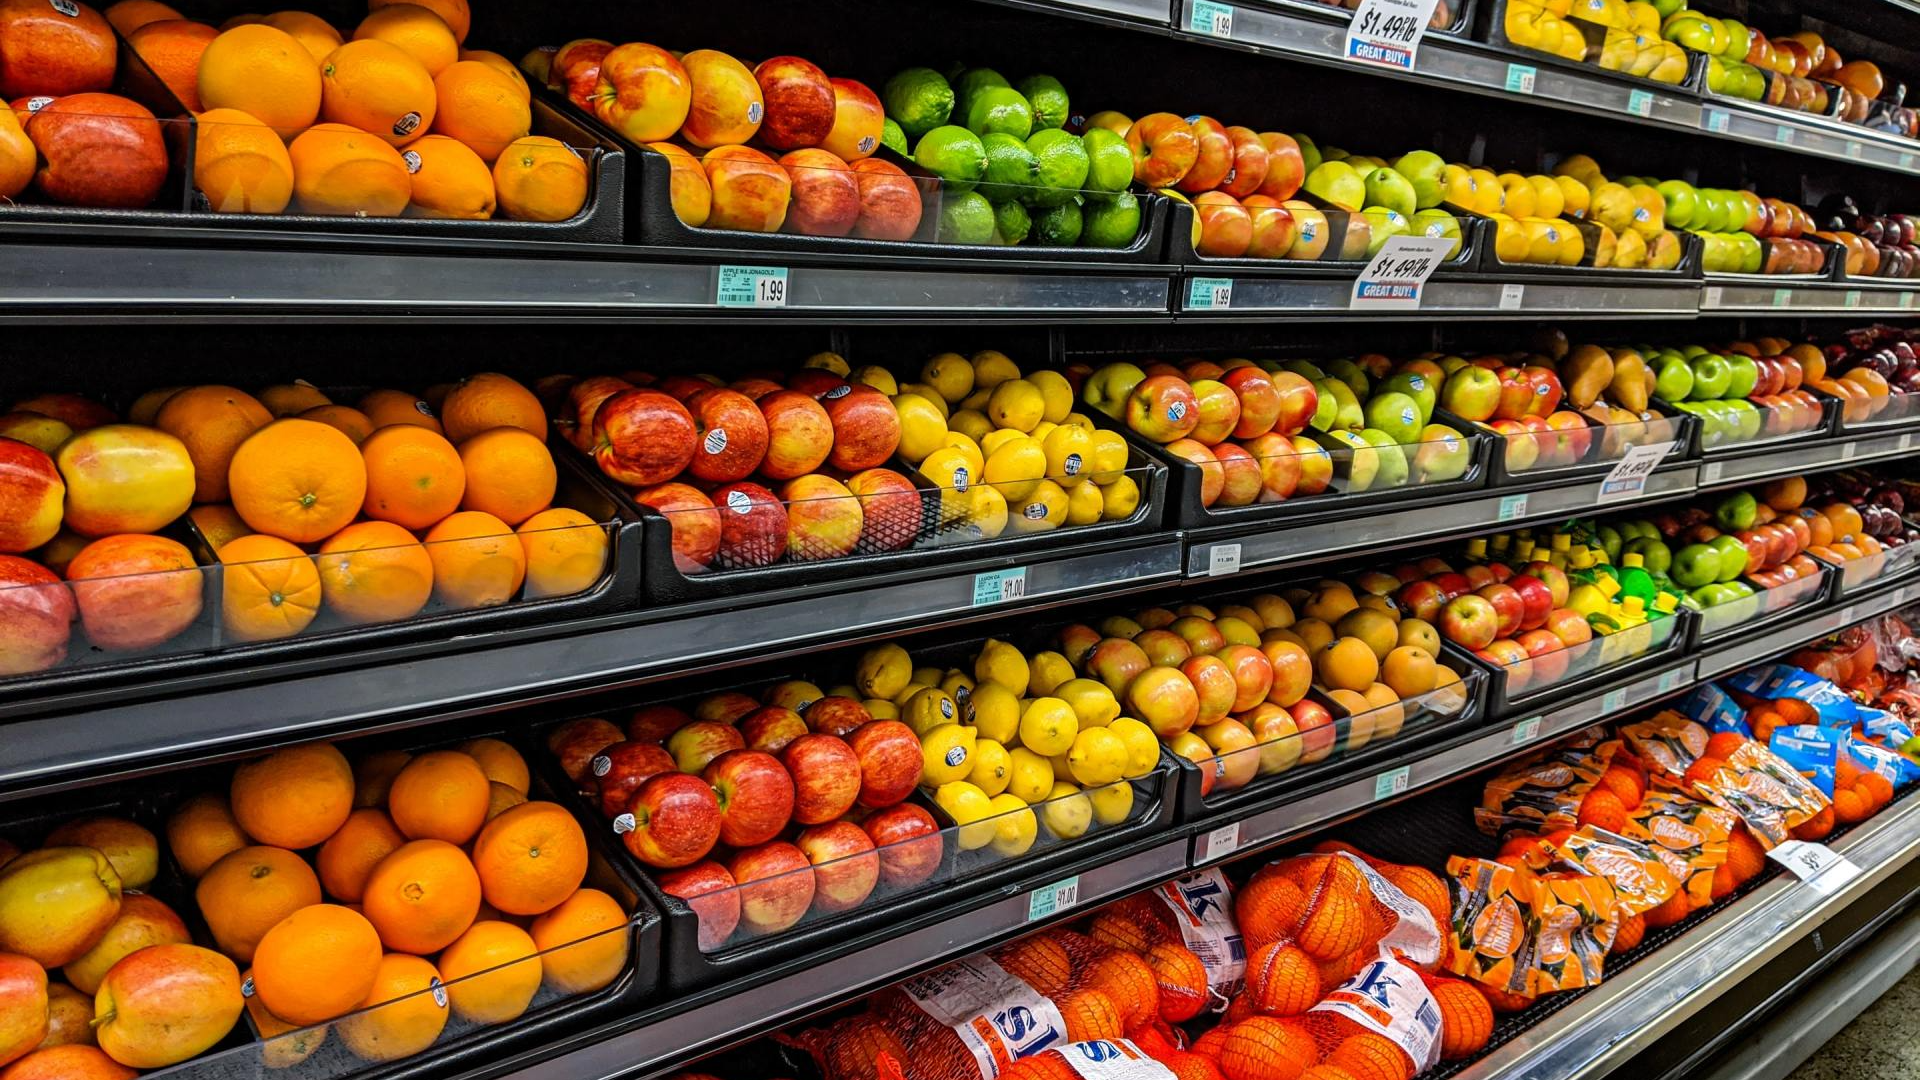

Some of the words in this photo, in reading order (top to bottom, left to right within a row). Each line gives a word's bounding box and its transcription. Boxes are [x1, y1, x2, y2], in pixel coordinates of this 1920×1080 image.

[1216, 15, 1230, 35] 1.99
[1360, 7, 1404, 39] $1.49
[1356, 43, 1384, 60] GREAT
[1385, 49, 1406, 65] BUY!
[1371, 257, 1414, 278] $1.49
[761, 280, 783, 301] 1.99
[1216, 288, 1229, 305] 1.99
[1364, 285, 1391, 297] GREAT
[1392, 285, 1413, 298] BUY!
